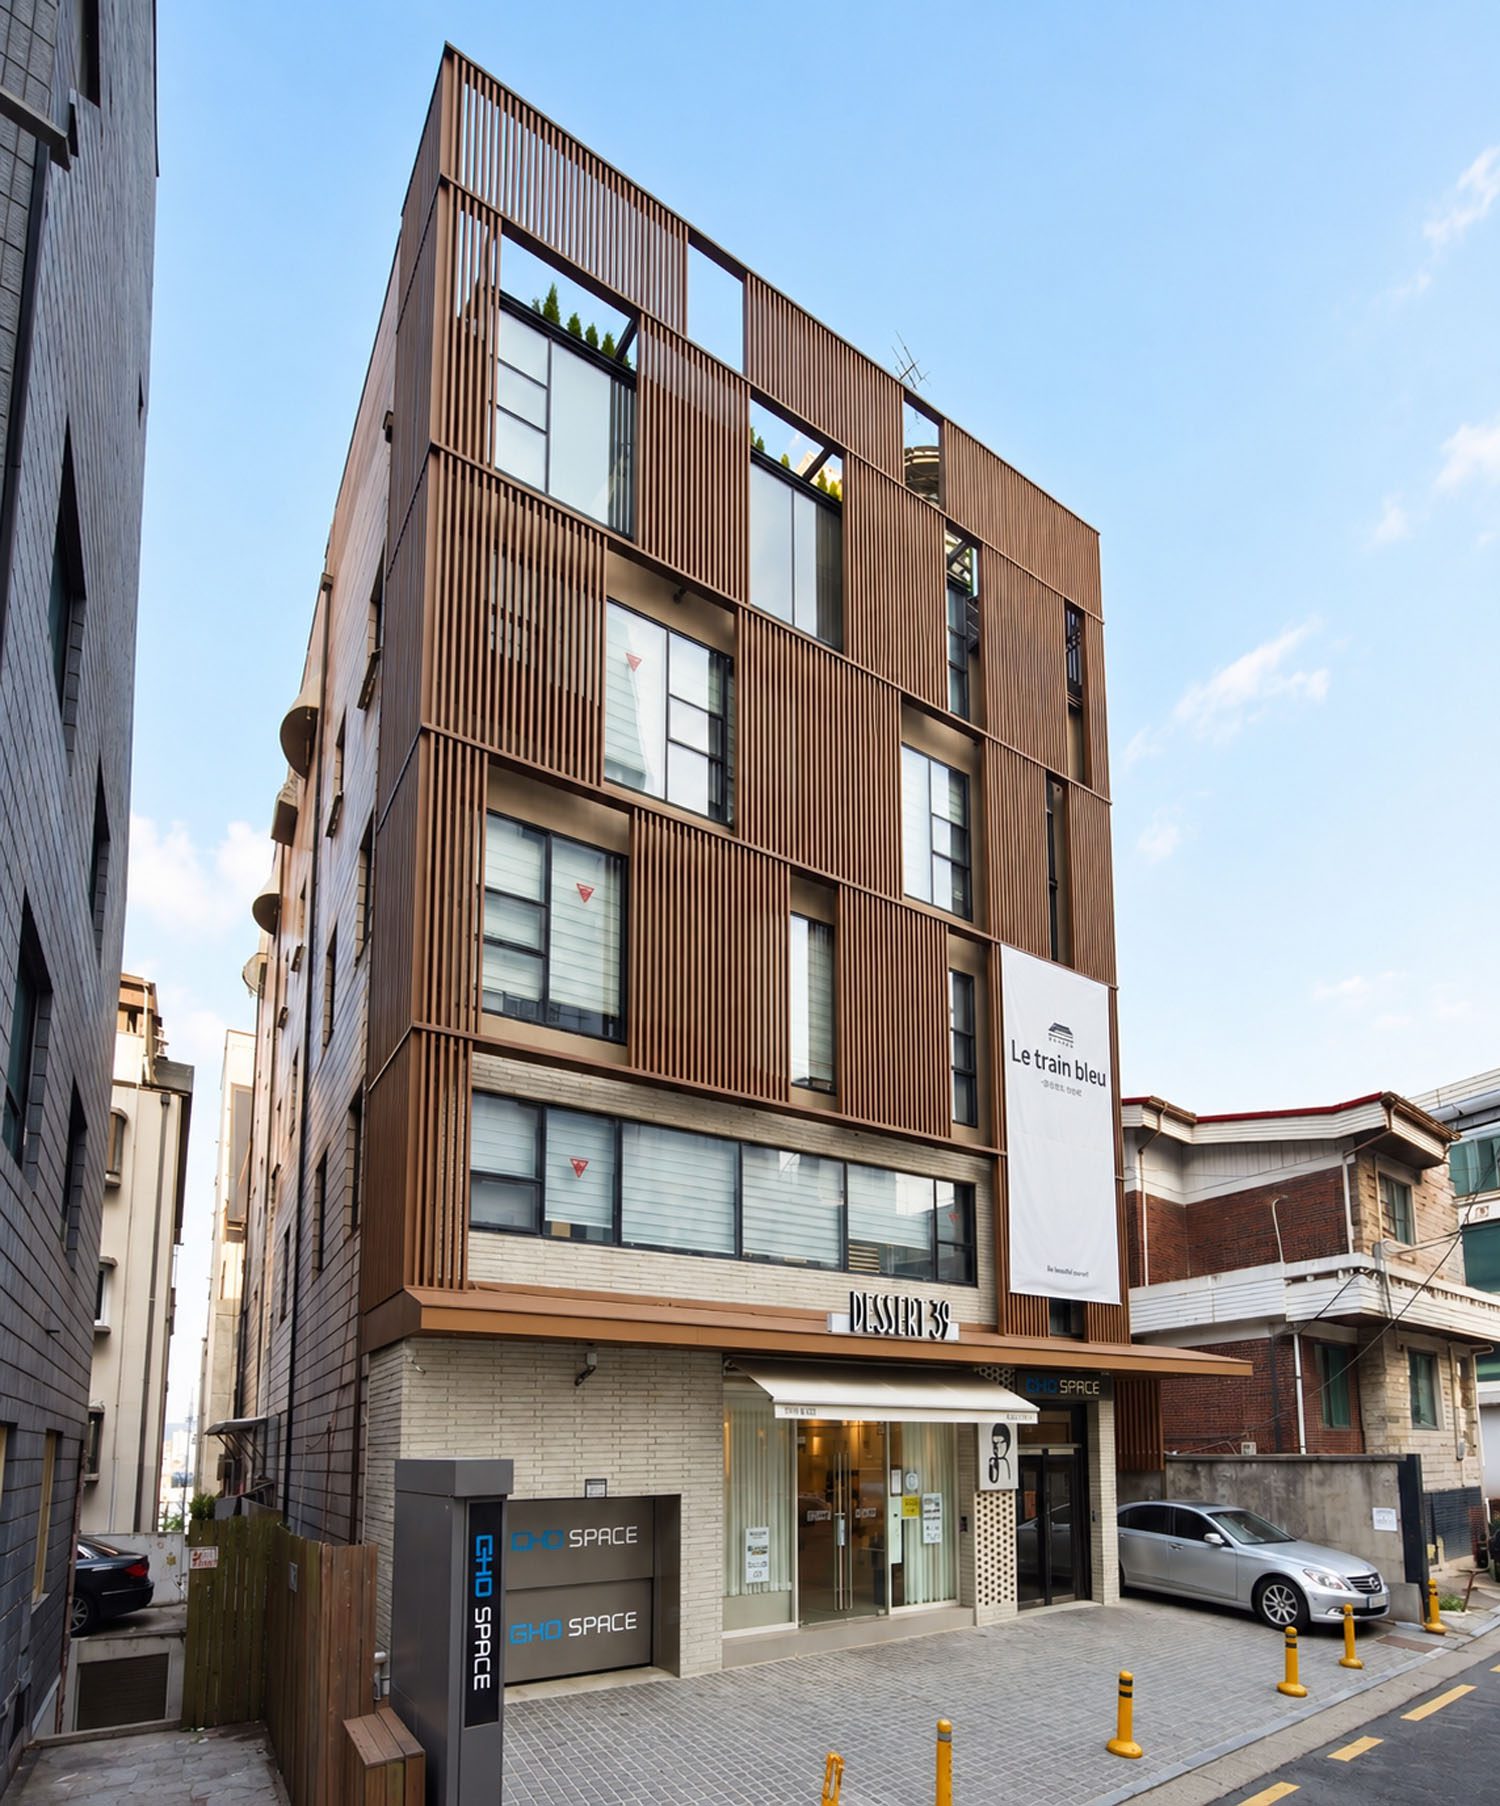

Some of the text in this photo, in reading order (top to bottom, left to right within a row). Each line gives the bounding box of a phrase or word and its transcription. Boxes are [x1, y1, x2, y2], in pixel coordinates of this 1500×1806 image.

[1011, 1039, 1031, 1066] Le
[1034, 1049, 1072, 1078] train
[1075, 1059, 1107, 1088] bleu
[849, 1290, 952, 1341] DESSERT 39
[1059, 1379, 1100, 1395] SPACE
[568, 1525, 638, 1548] SPACE
[473, 1534, 494, 1691] GHO SPACE
[508, 1611, 638, 1645] GHO SPACE
